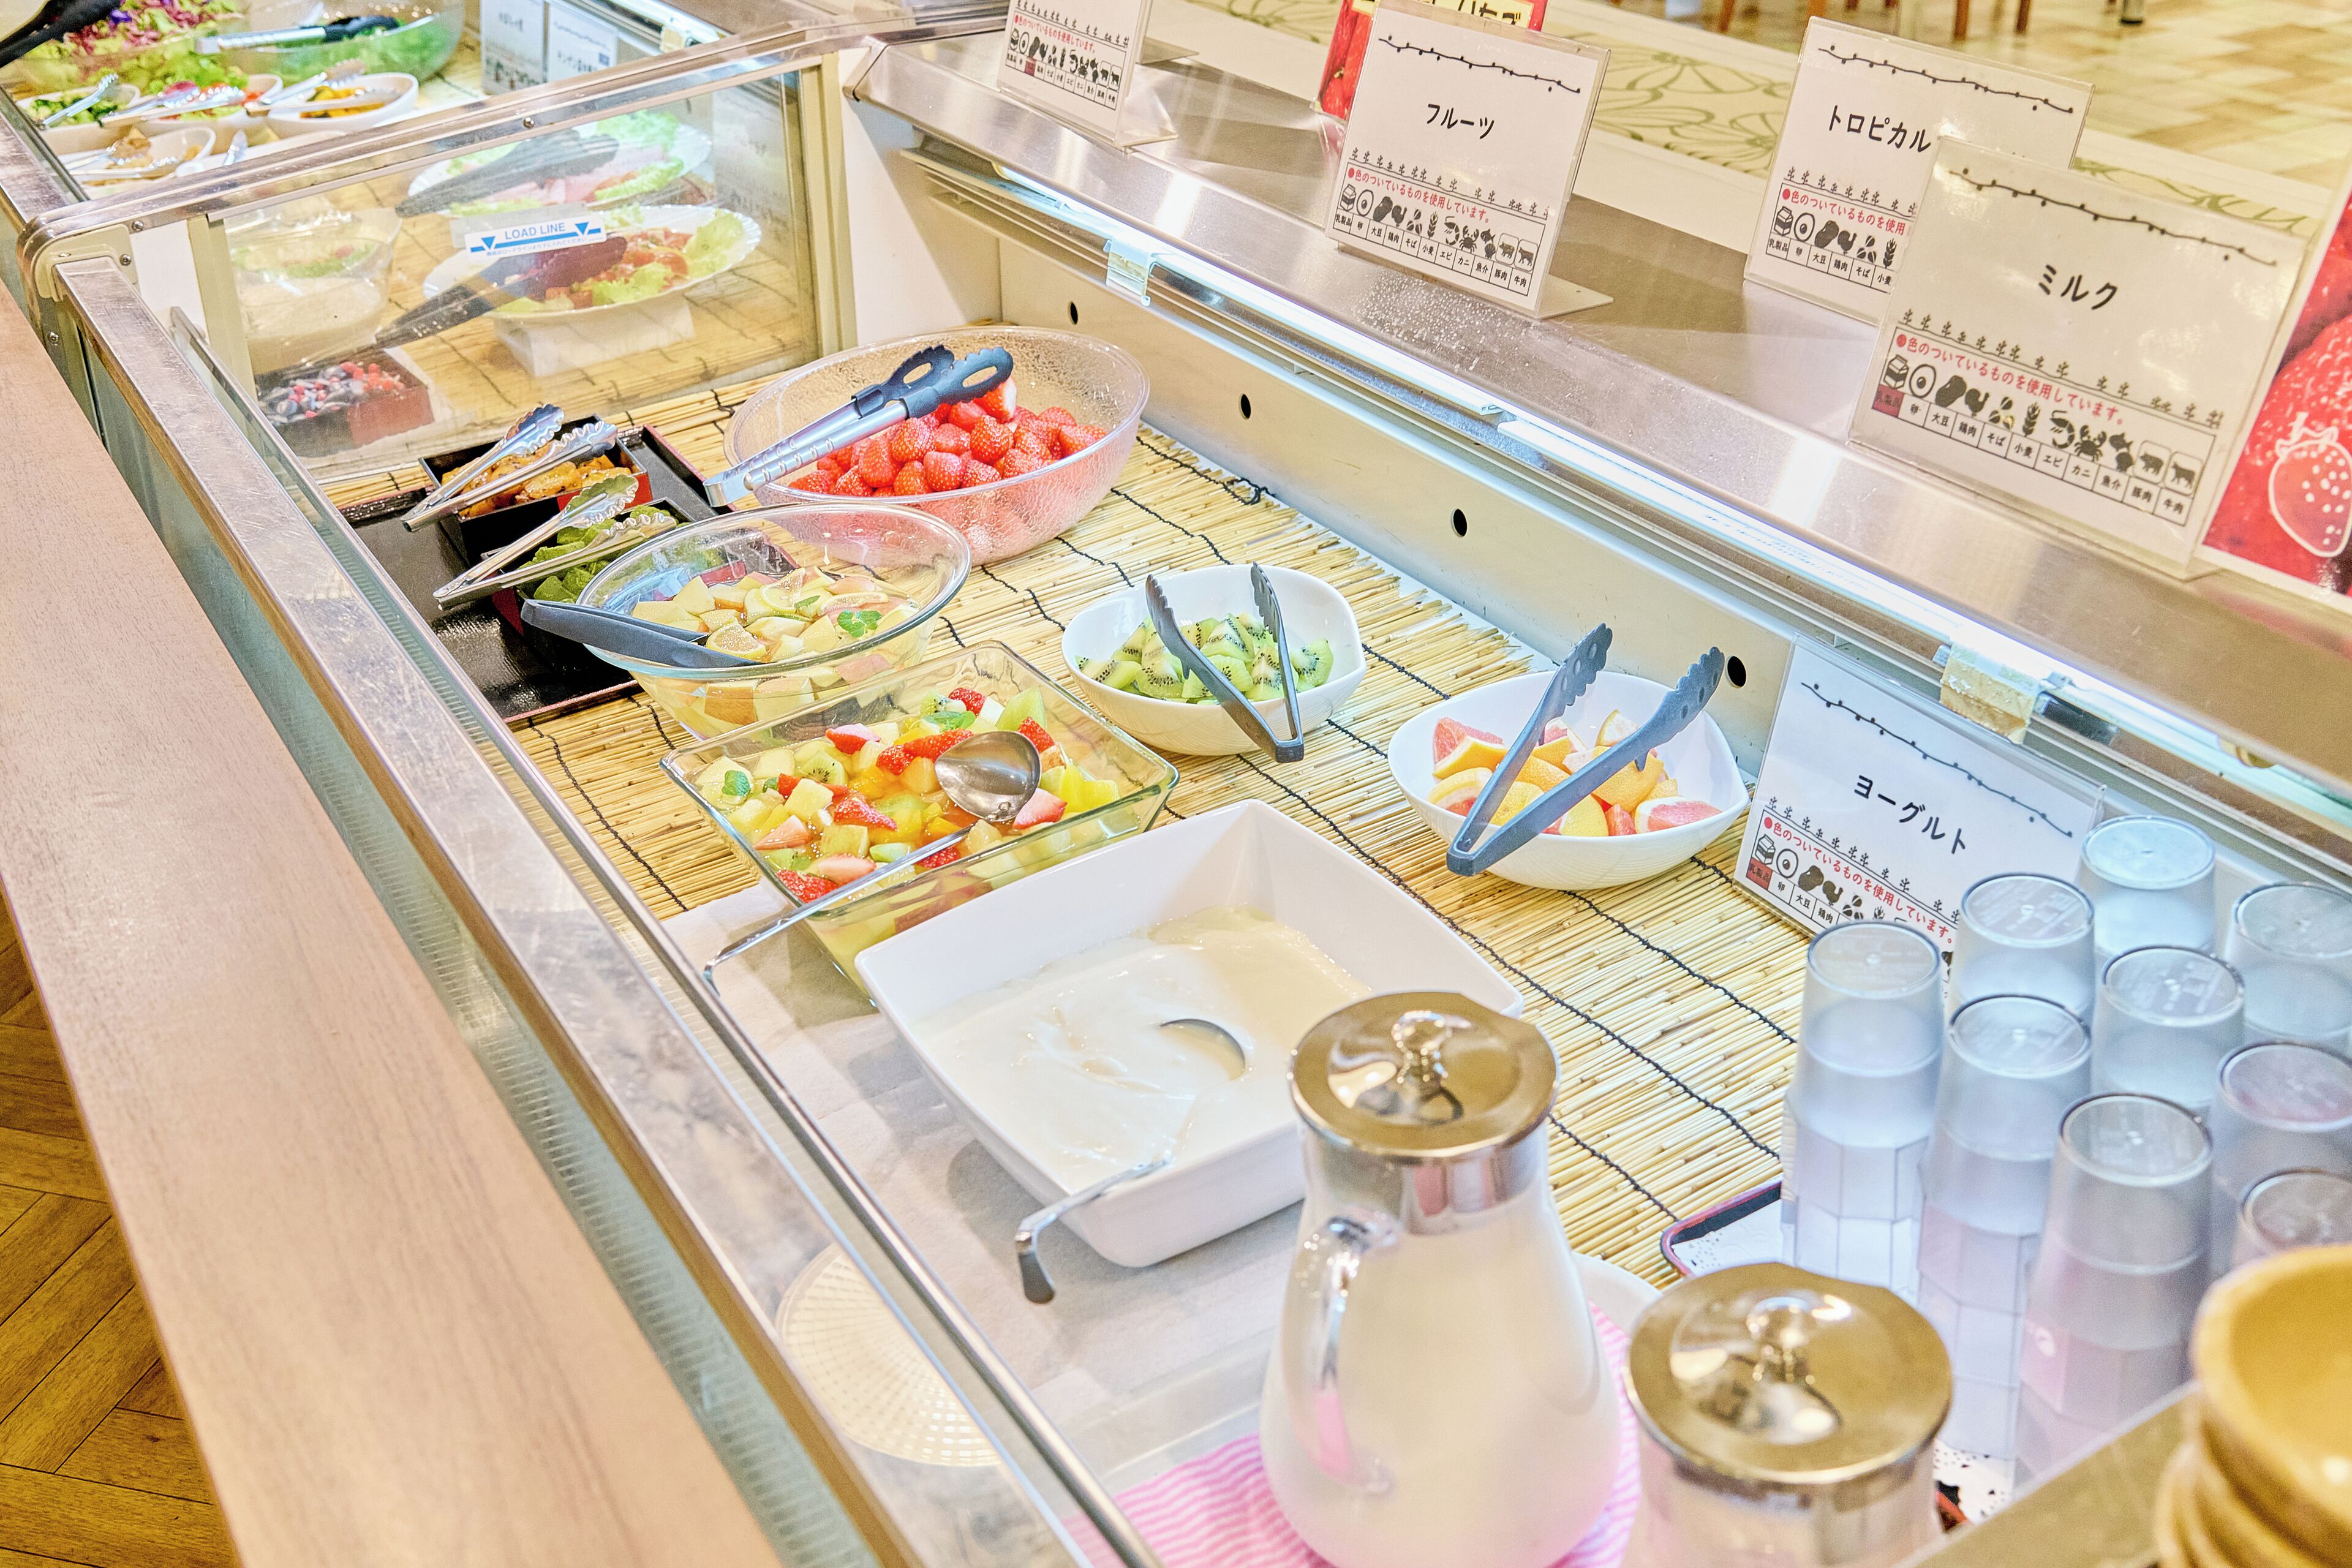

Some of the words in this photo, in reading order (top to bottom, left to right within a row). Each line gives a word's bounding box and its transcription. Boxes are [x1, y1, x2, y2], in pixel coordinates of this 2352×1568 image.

[1426, 103, 1495, 140] フルーツ
[1828, 104, 1932, 153] トロピカル
[1355, 169, 1489, 224] 色のついているものを使用しています。
[505, 227, 537, 239] LOAD
[540, 222, 566, 234] LINE
[1357, 221, 1363, 231] 卵
[1371, 227, 1382, 238] 大豆
[1387, 232, 1400, 243] 鶏肉
[1406, 238, 1418, 249] そば
[1422, 244, 1434, 255] 小麦
[1439, 251, 1453, 261] エビ
[1457, 256, 1470, 266] カニ
[1475, 262, 1489, 274] 魚介
[1494, 268, 1508, 281] 豚肉
[1513, 275, 1527, 288] 牛肉
[1769, 238, 1789, 253] 乳製品
[1795, 246, 1803, 257] 卵
[1812, 253, 1827, 265] 大豆
[1833, 258, 1848, 272] 鶏肉
[1855, 266, 1871, 279] そば
[1877, 273, 1893, 287] 小麦
[2038, 264, 2117, 311] ミルク
[1906, 336, 2124, 426] 色のついているものを使用しています。
[1910, 403, 1920, 415] 卵
[1931, 412, 1950, 428] 大豆
[1959, 421, 1978, 438] 鶏肉
[1986, 432, 2007, 447] そば
[2014, 443, 2034, 459] 小麦
[2042, 454, 2064, 468] エビ
[2071, 464, 2091, 478] カニ
[2100, 474, 2121, 491] 魚介
[2131, 485, 2153, 503] 豚肉
[2163, 497, 2185, 515] 牛肉
[1853, 774, 1966, 855] ヨーグルト
[1749, 861, 1771, 883] 乳製品
[1777, 881, 1787, 892] 卵
[1795, 893, 1811, 910] 大豆
[1817, 907, 1834, 924] 鶏肉
[1773, 821, 1953, 944] 色のついているものを使用しています。
